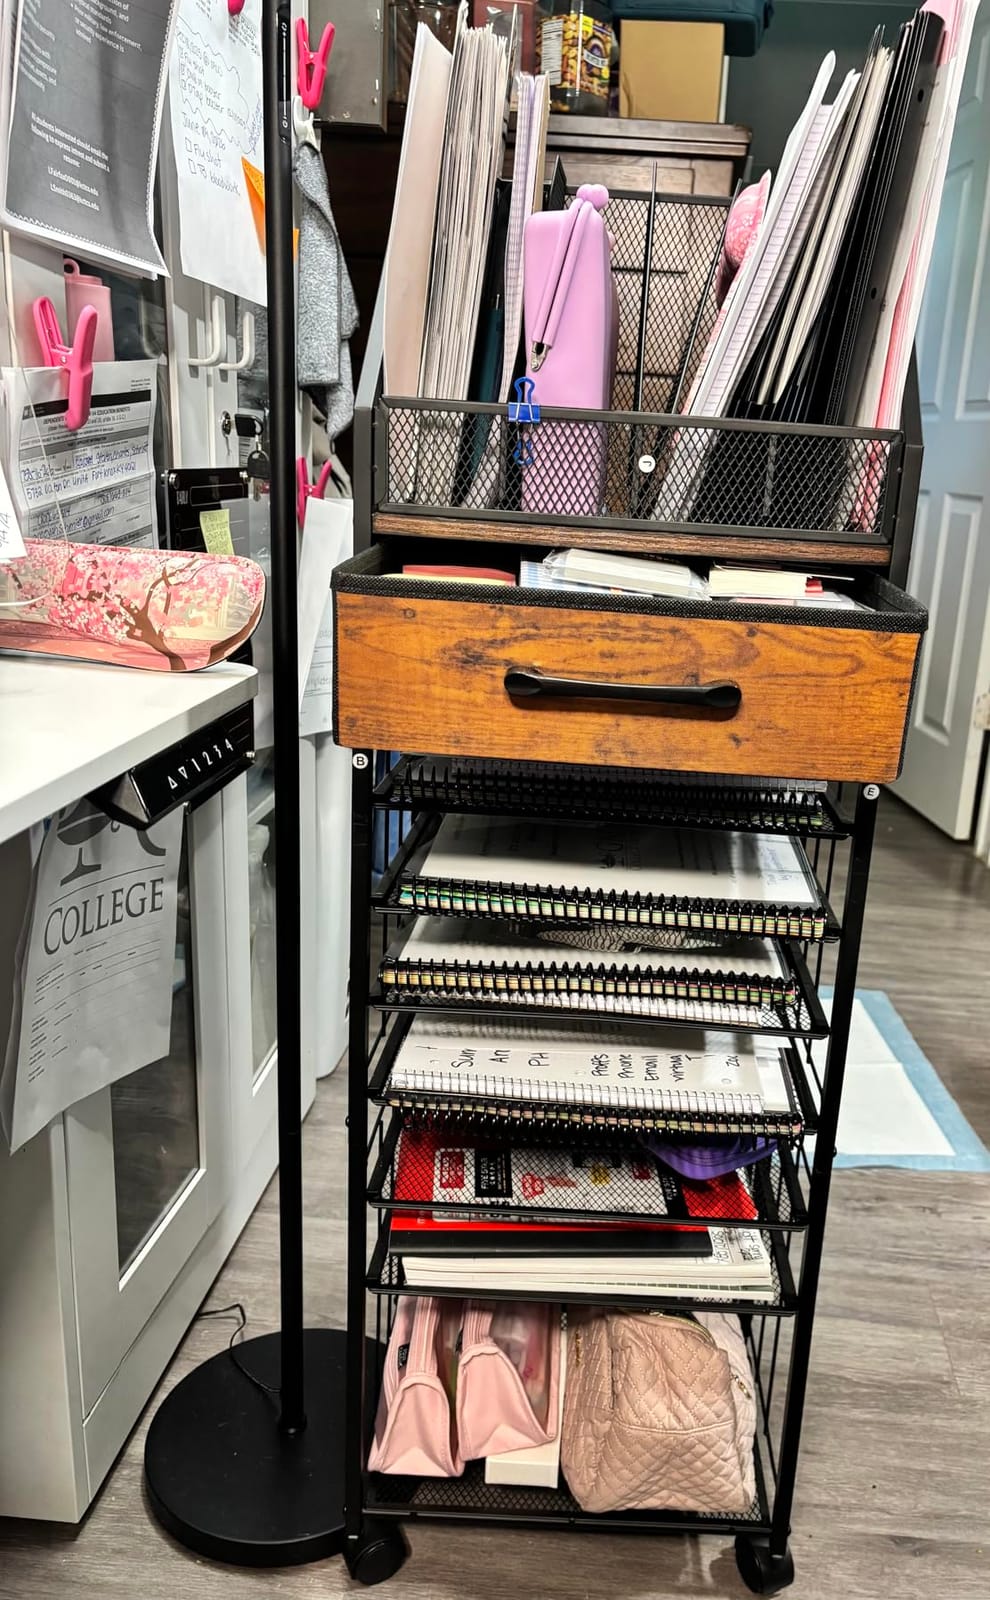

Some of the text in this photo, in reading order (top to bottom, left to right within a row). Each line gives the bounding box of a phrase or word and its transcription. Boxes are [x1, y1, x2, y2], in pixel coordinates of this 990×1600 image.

[202, 751, 213, 765] 2
[44, 877, 165, 955] COLLEGE
[643, 1055, 660, 1081] Email
[670, 1053, 685, 1082] virtua
